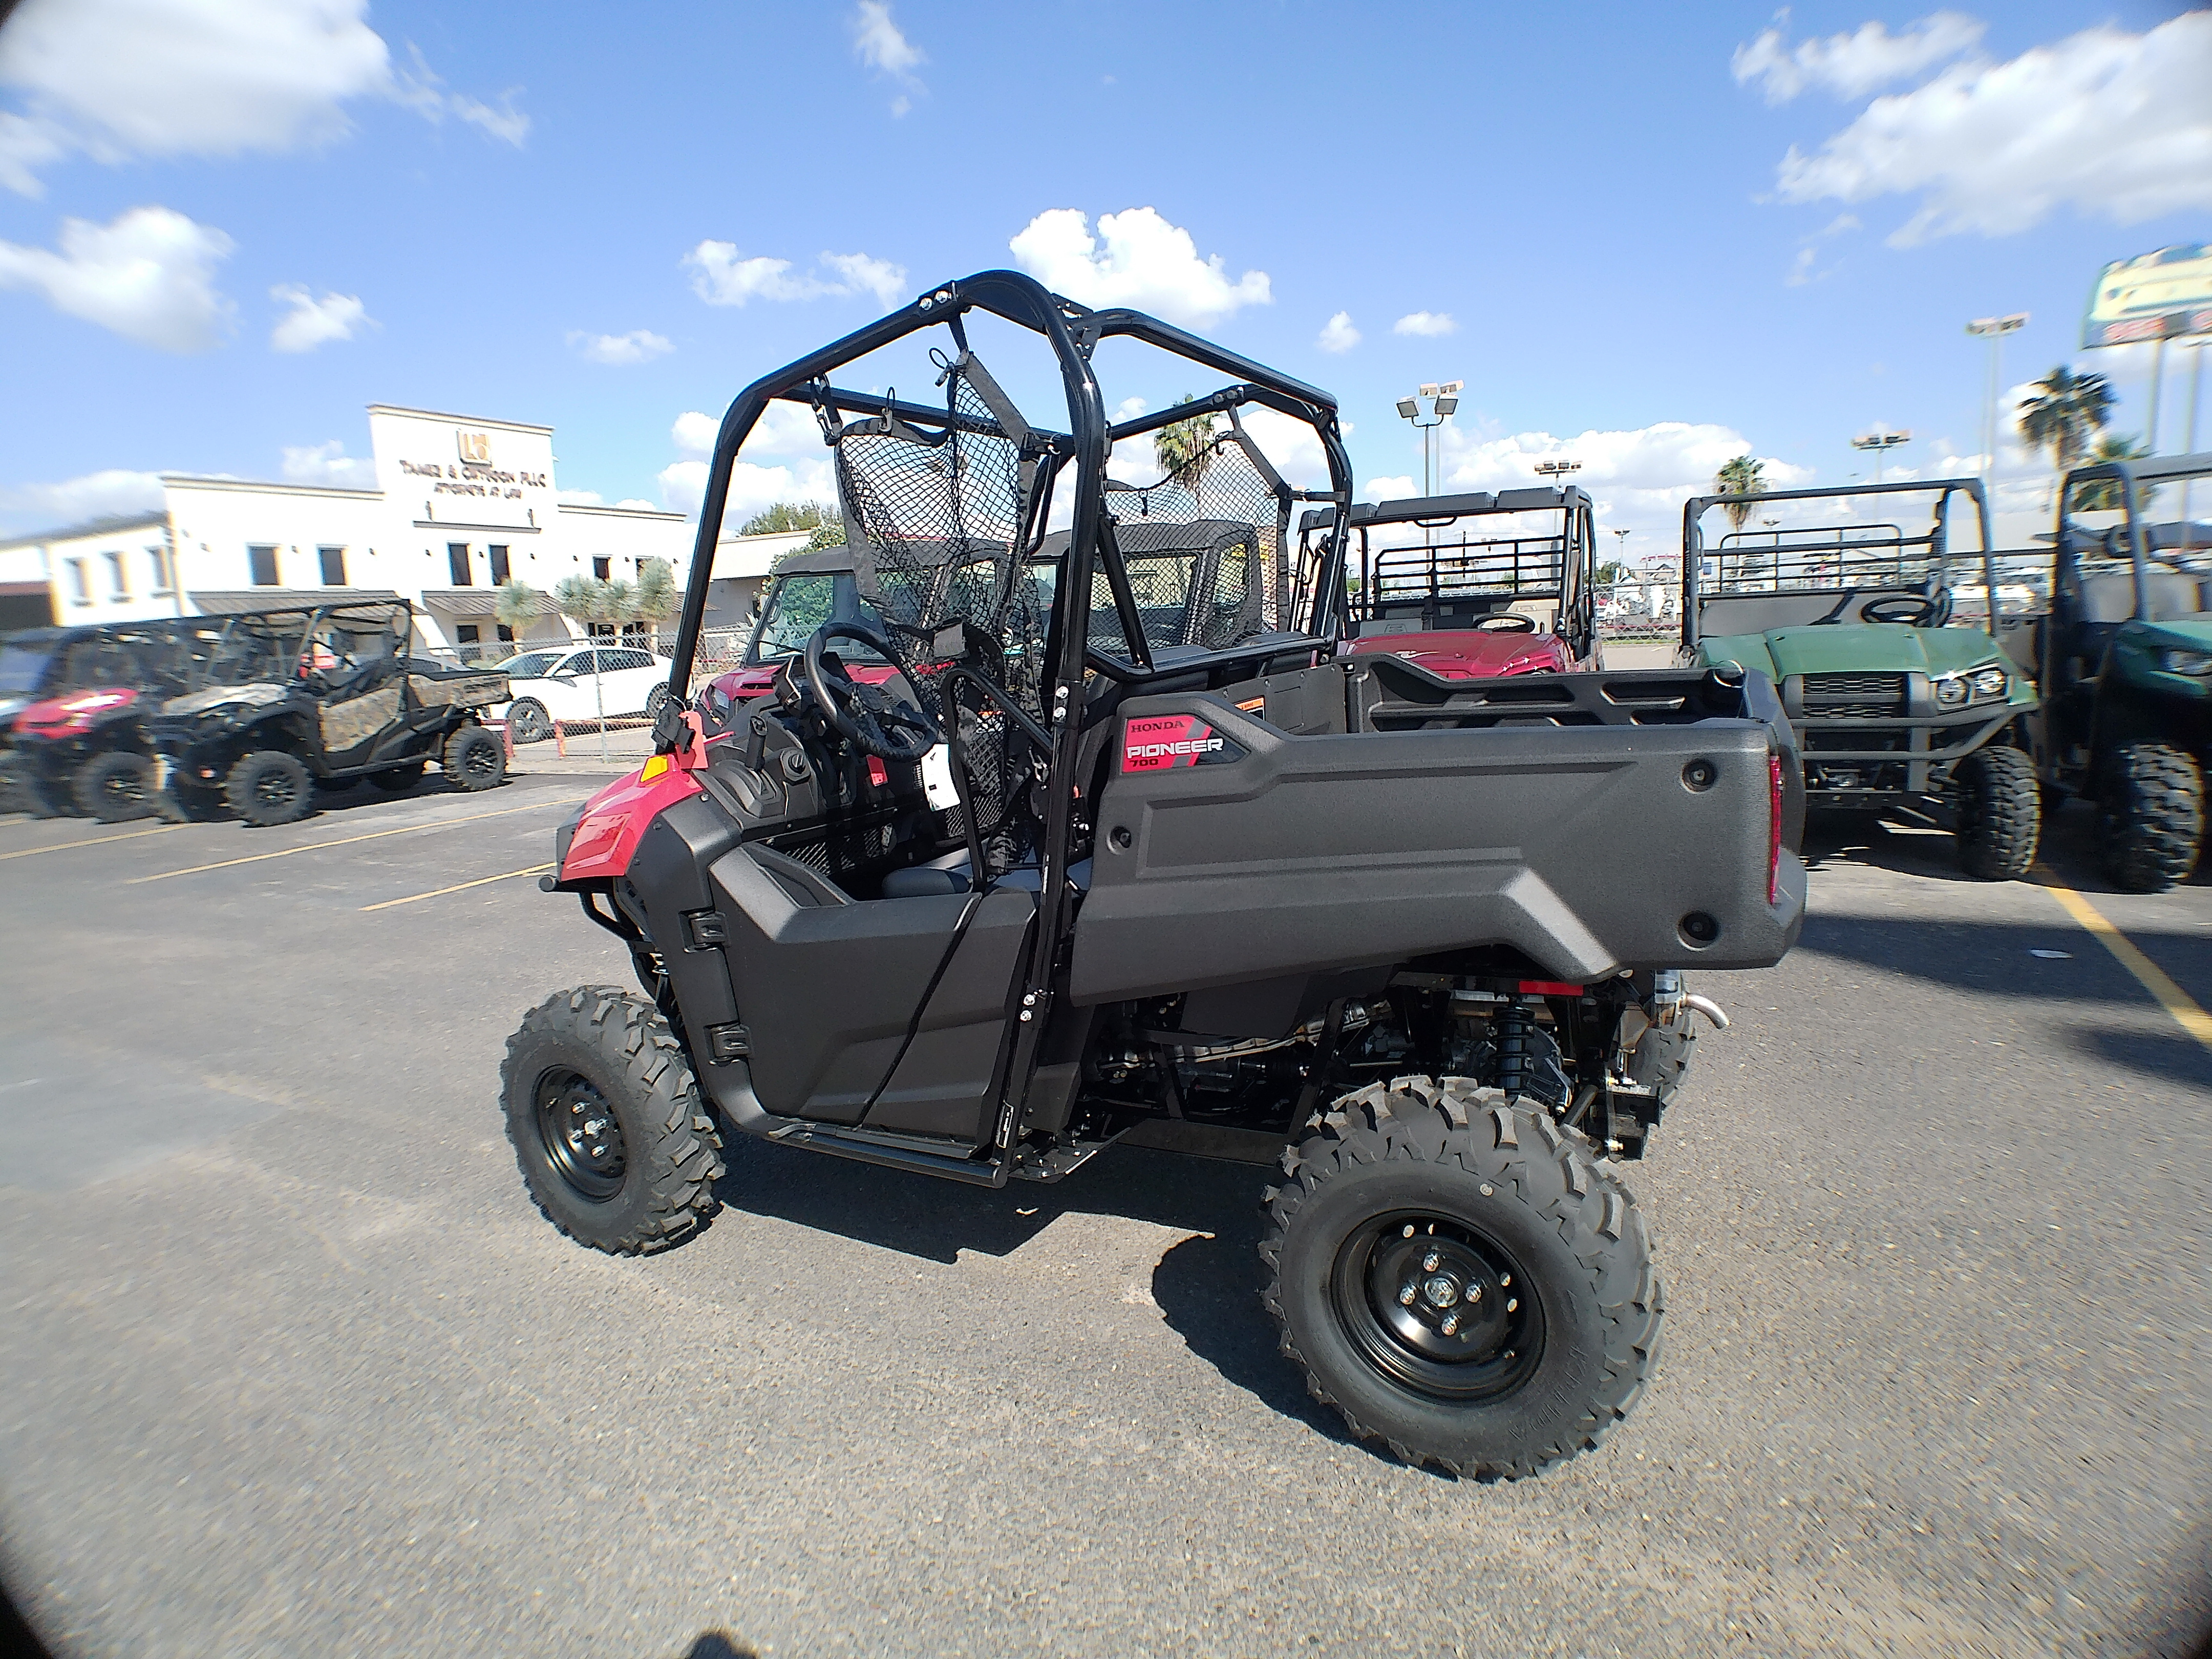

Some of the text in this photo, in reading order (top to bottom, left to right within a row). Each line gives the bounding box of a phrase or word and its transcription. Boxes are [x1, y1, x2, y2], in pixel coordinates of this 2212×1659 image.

[1131, 720, 1185, 733] HONDA
[1127, 738, 1223, 758] PIONEER
[1129, 758, 1159, 768] 700
